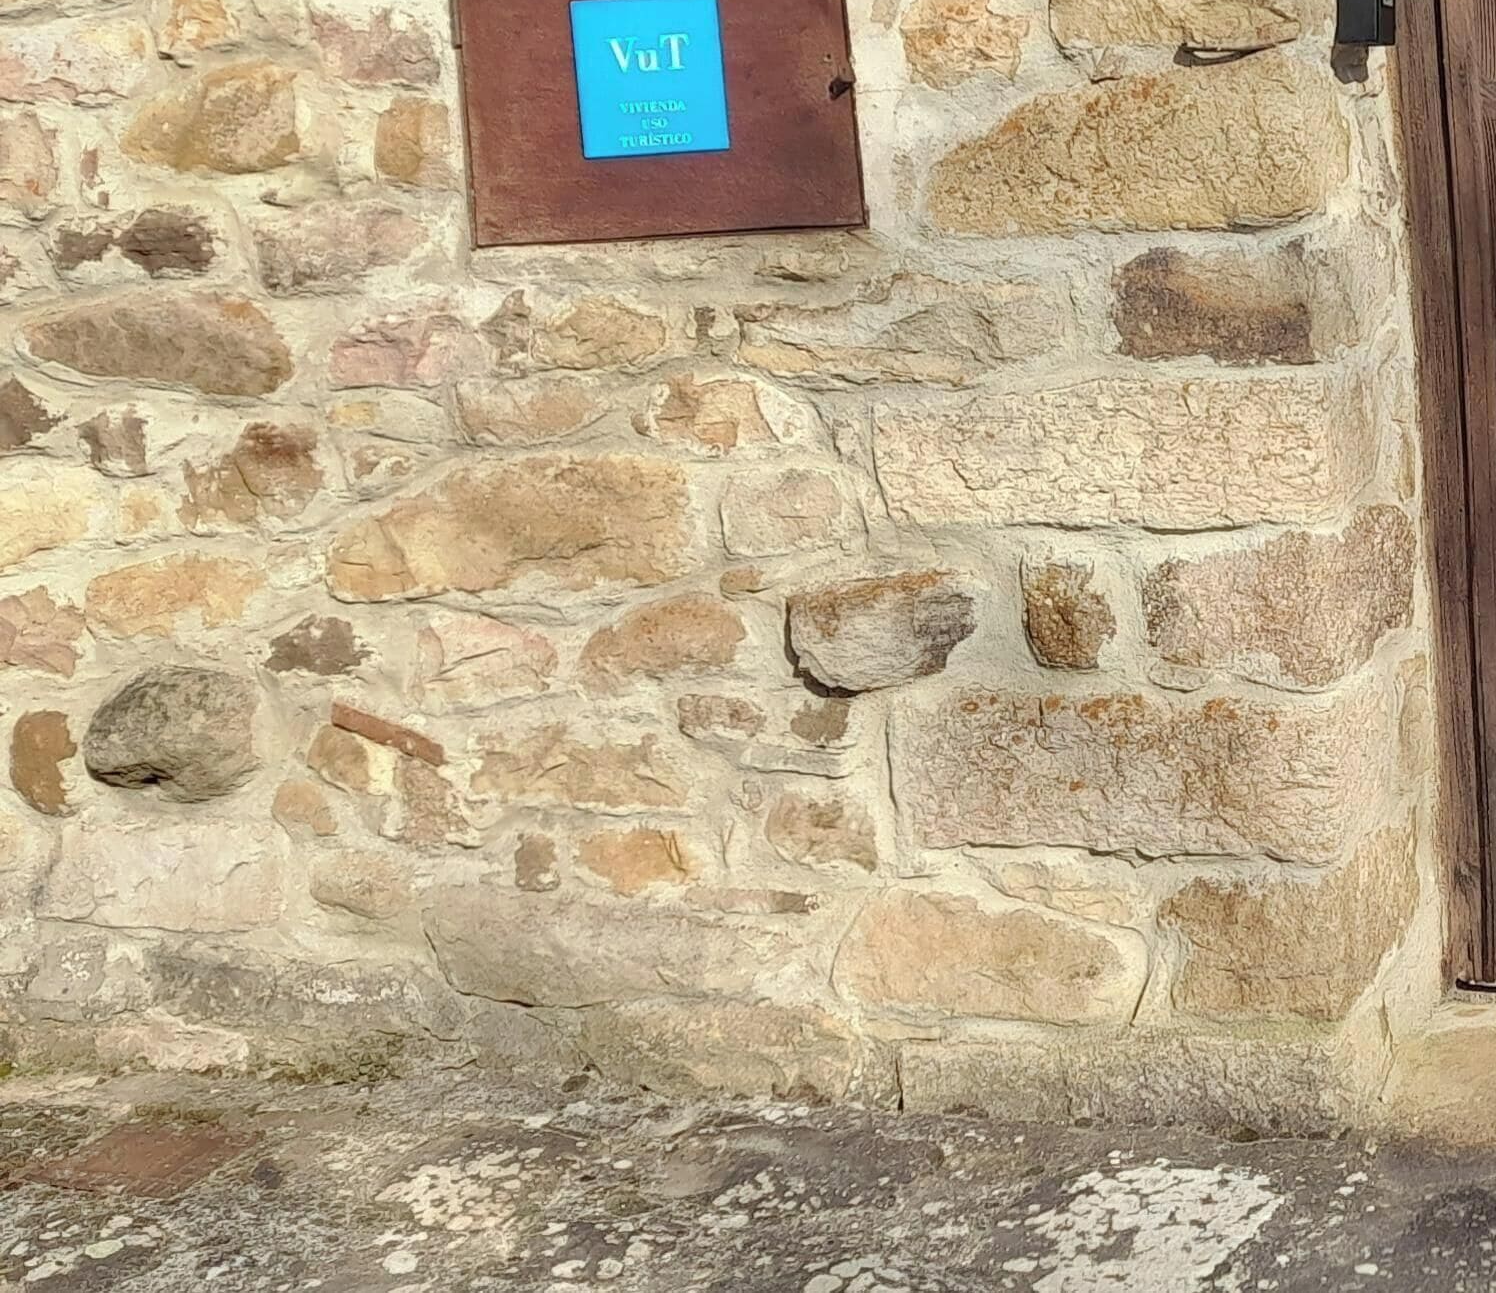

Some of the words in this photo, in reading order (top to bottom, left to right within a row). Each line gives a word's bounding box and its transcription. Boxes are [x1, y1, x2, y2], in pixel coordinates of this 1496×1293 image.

[607, 33, 690, 74] VuT
[618, 99, 686, 114] VIVIENDA
[640, 117, 668, 130] USO
